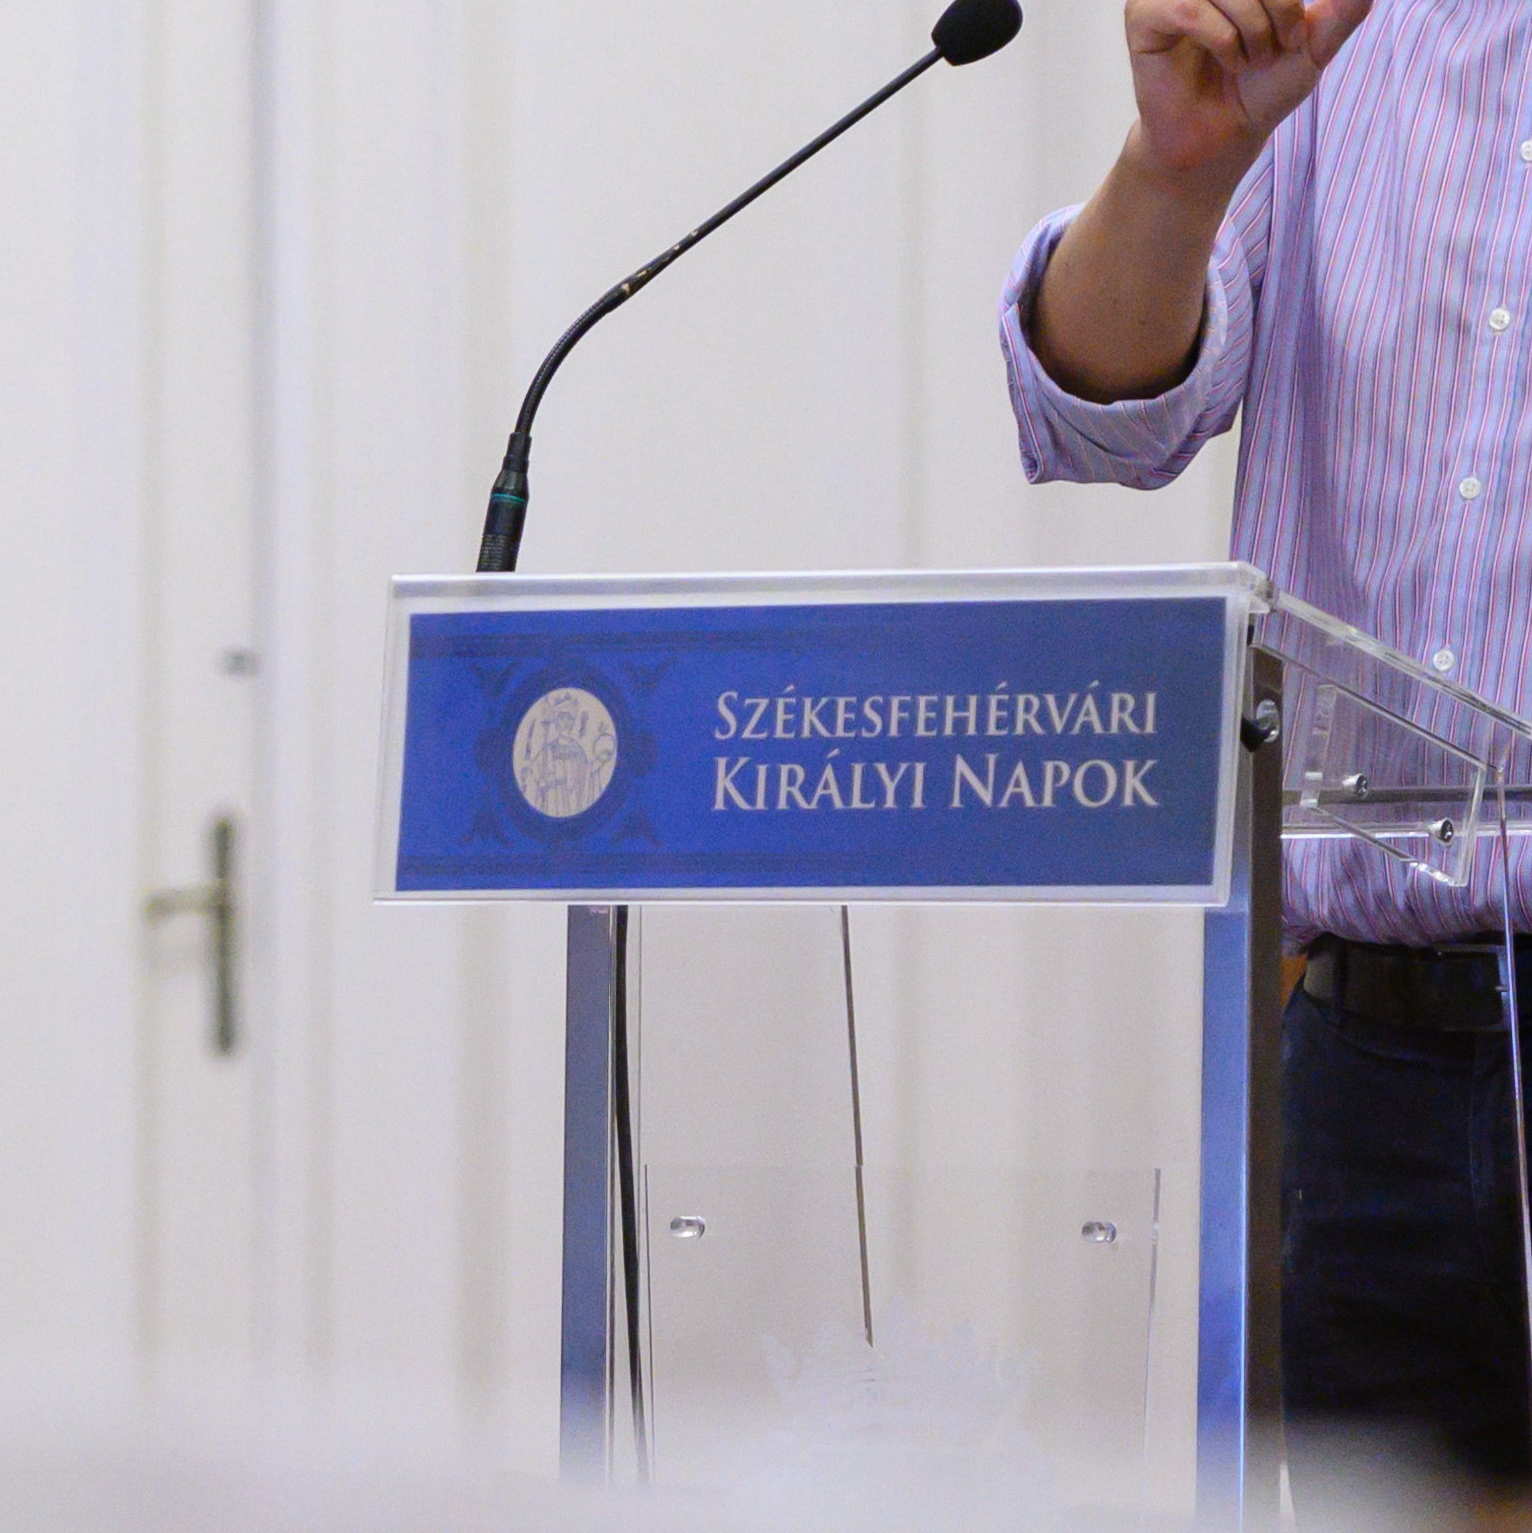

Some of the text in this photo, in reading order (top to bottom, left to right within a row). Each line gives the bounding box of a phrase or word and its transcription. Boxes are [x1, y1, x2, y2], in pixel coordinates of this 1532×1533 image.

[714, 679, 1158, 739] SZÉKESFEHÉRVÁRI
[712, 747, 1160, 811] KIRÁLYI NAPOK
